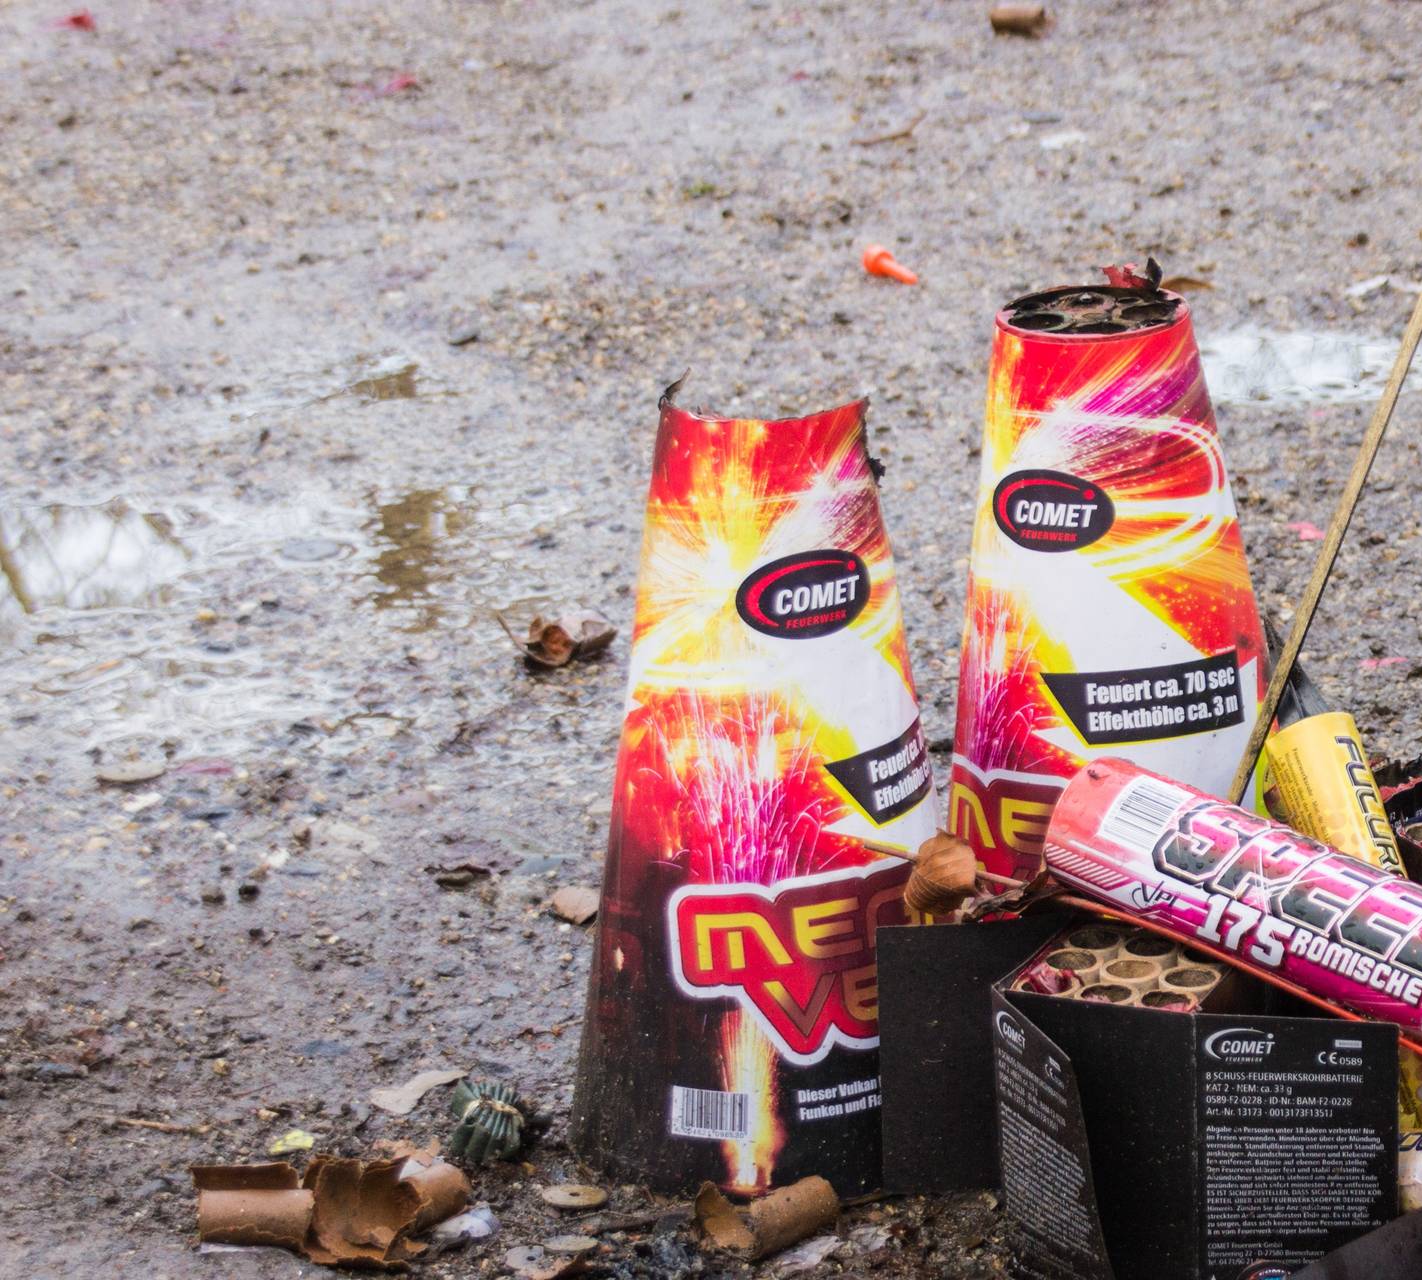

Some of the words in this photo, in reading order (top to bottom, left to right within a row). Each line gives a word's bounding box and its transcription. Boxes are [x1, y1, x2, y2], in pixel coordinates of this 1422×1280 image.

[1015, 500, 1097, 528] COMET
[1020, 530, 1077, 541] FEUERWERK
[776, 575, 860, 615] COMET
[786, 609, 847, 629] FEUERWERK
[1086, 681, 1152, 705] Feuert
[1155, 678, 1183, 698] ca.
[1185, 670, 1206, 692] 70
[1208, 666, 1235, 688] sec
[1089, 704, 1185, 732] Effekthöhe
[1188, 701, 1212, 720] ca.
[1214, 697, 1224, 716] 3
[1227, 696, 1238, 713] m
[951, 783, 1057, 856] ME
[1195, 893, 1297, 967] 175
[1003, 1022, 1025, 1048] COMET
[1221, 1041, 1275, 1054] COMET
[1339, 1057, 1362, 1065] 0589
[1206, 1084, 1222, 1092] KAT
[1224, 1084, 1229, 1092] 2
[1214, 1072, 1364, 1083] SCHUSS-FEUERWERKSROHRBATTERIE
[798, 1085, 838, 1103] Dieser
[838, 1078, 877, 1096] Vulkan
[800, 1103, 843, 1121] Funken
[845, 1098, 866, 1113] und
[1238, 1108, 1262, 1116] 13173
